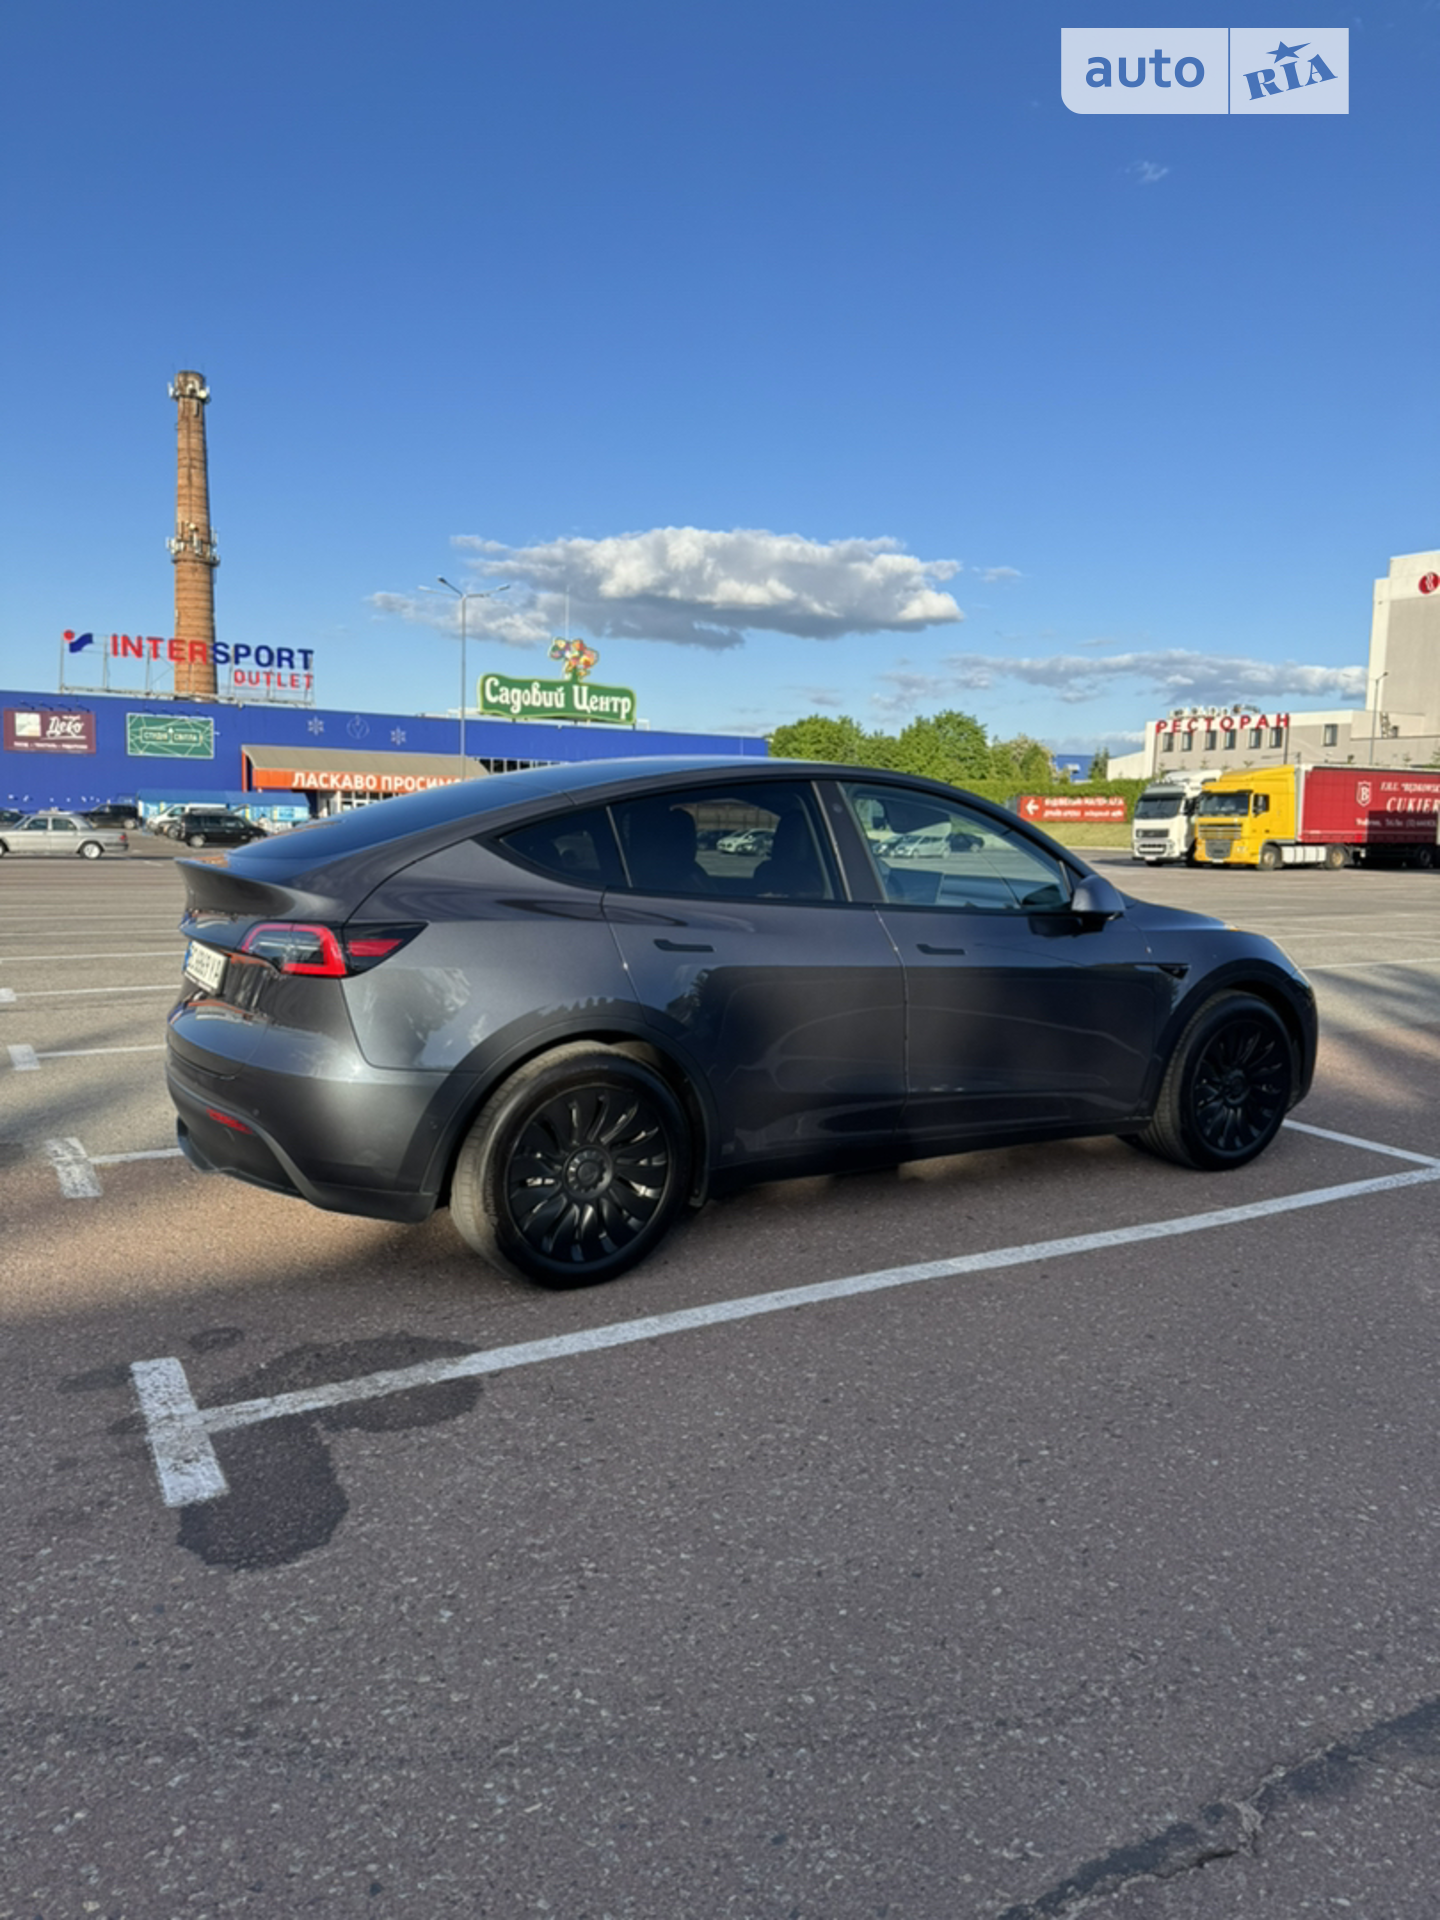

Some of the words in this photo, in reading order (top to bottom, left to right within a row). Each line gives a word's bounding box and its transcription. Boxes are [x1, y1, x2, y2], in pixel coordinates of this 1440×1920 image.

[110, 633, 314, 670] INTERSPORT
[234, 668, 313, 690] OUTLET
[484, 676, 566, 714] Садовий
[572, 684, 632, 720] Центр
[1155, 712, 1290, 734] РЕСТОРАН
[292, 772, 377, 789] ЛАСКАВО
